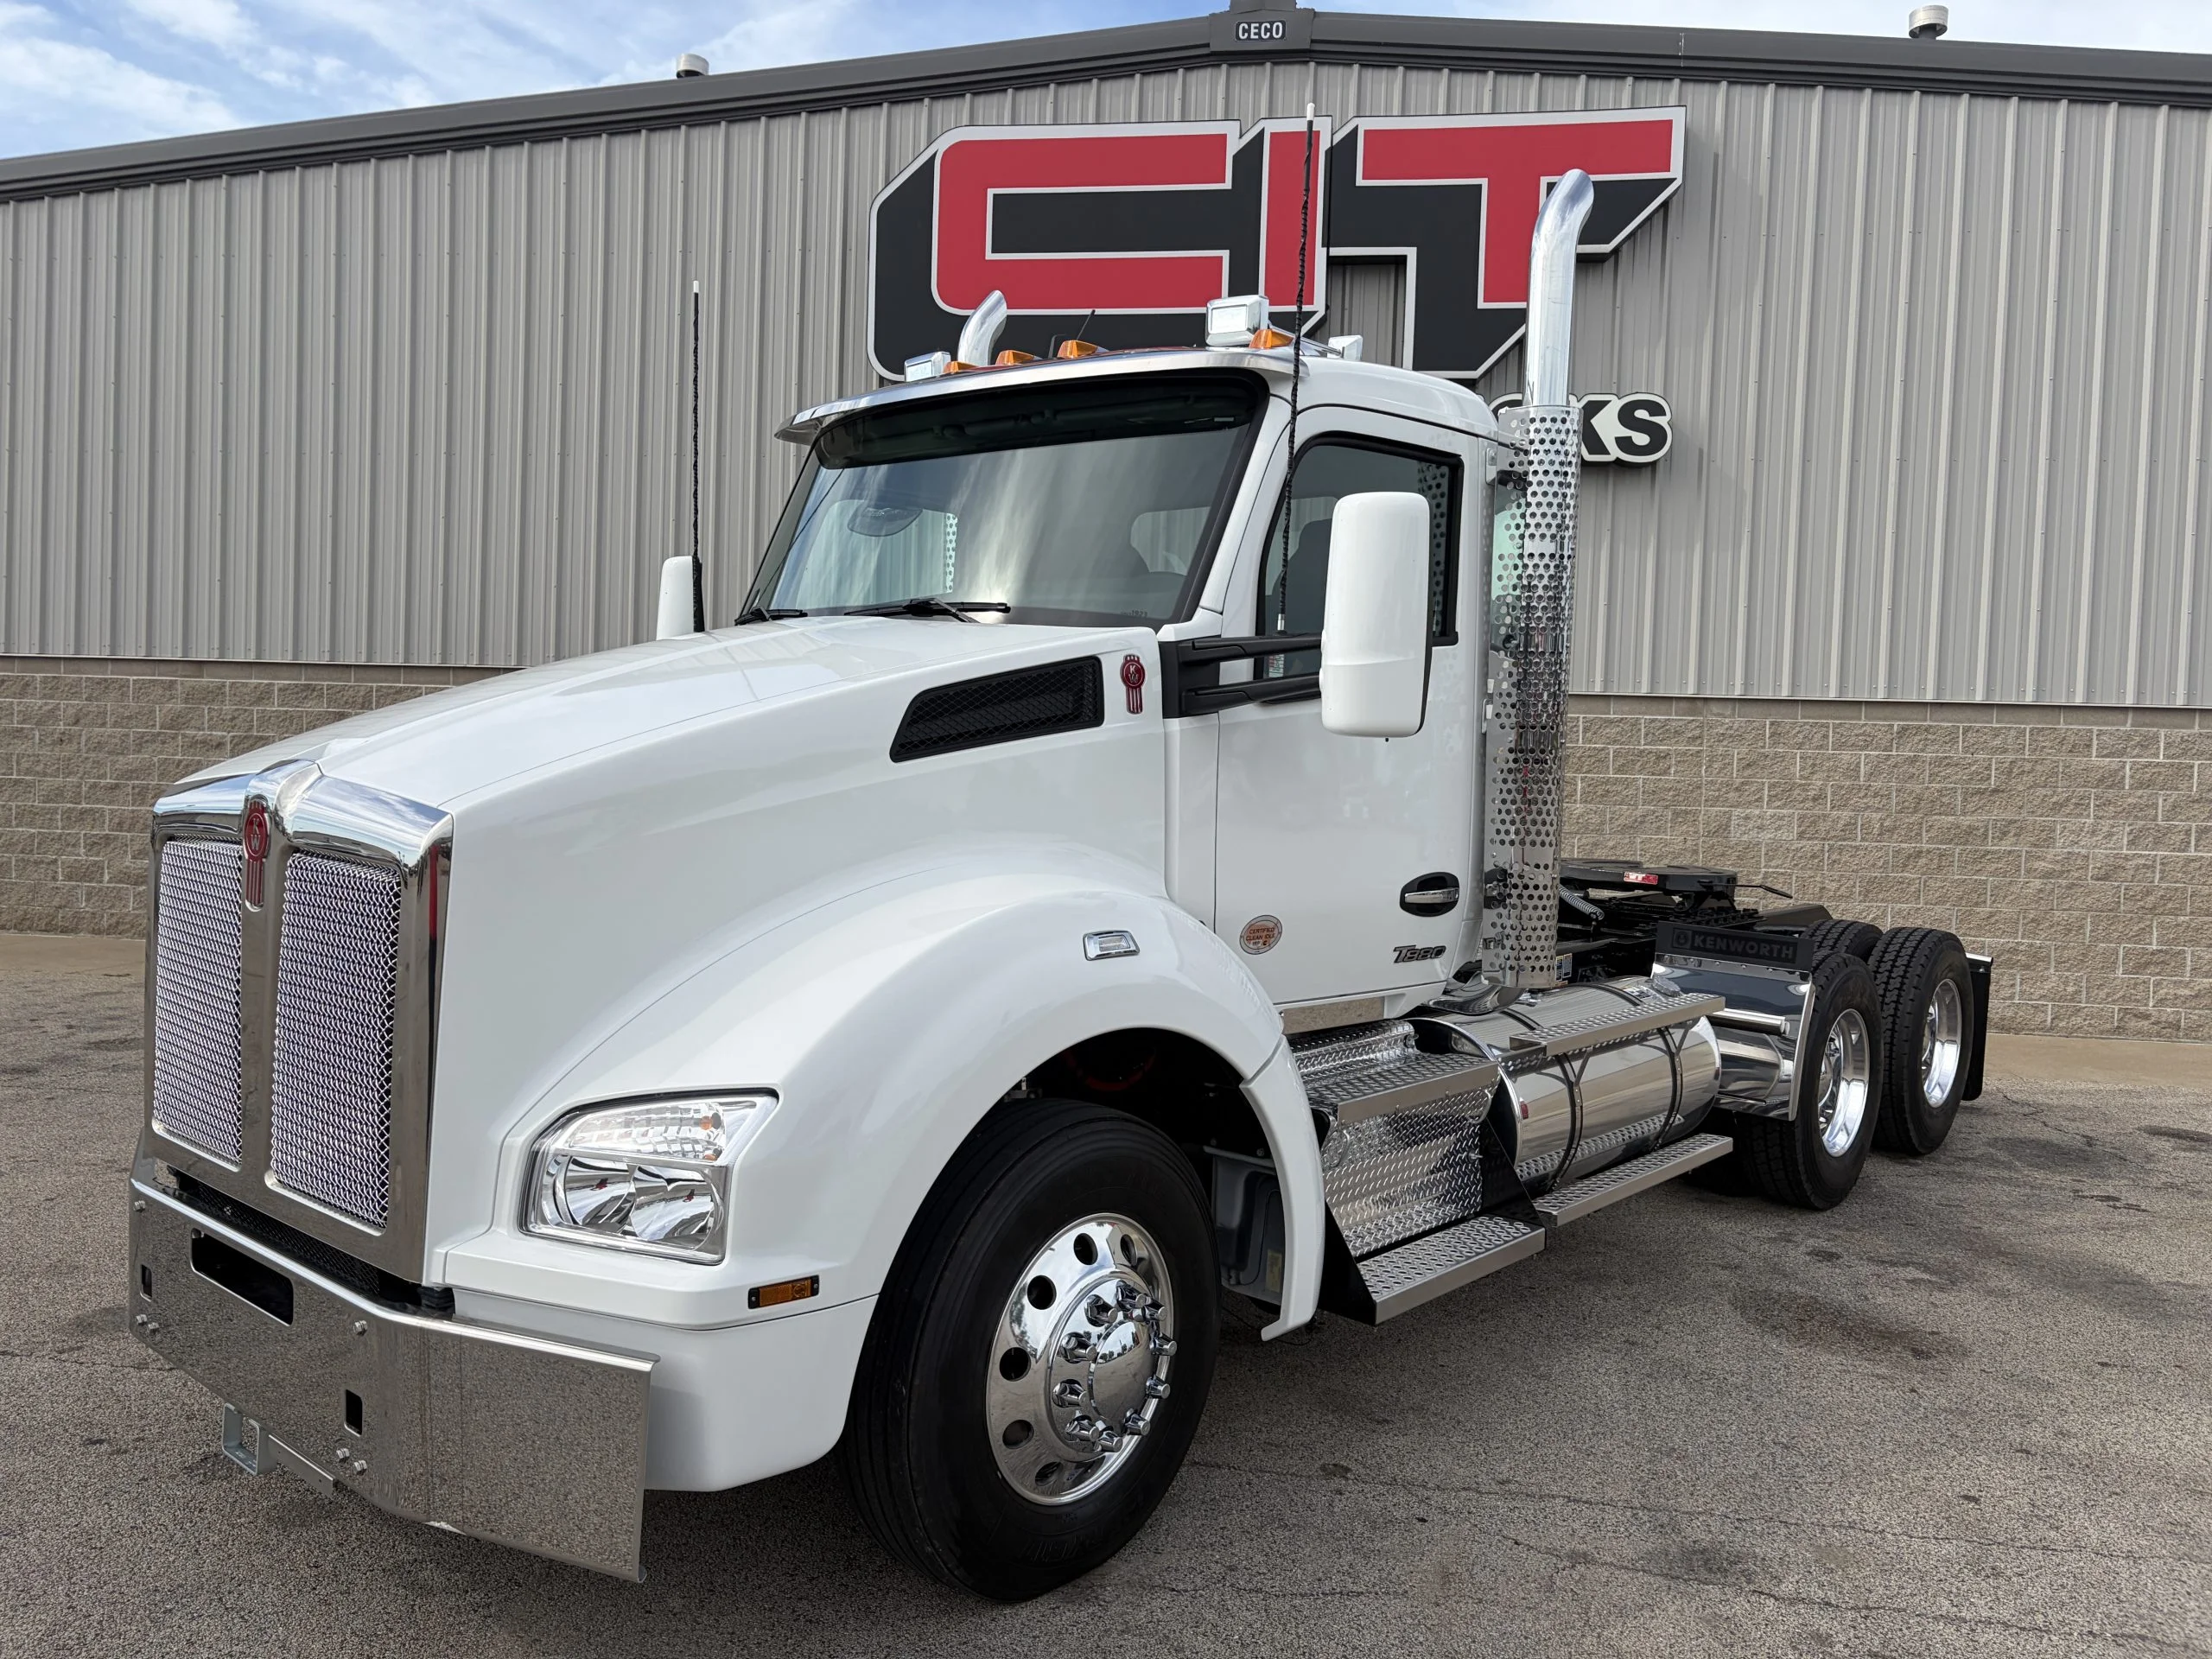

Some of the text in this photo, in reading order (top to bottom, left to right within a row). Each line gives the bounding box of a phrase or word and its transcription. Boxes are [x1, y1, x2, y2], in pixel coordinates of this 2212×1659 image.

[1238, 22, 1283, 40] CECO
[931, 107, 1686, 316] CIT
[1393, 944, 1446, 963] T880
[1694, 934, 1795, 959] KENWORTH
